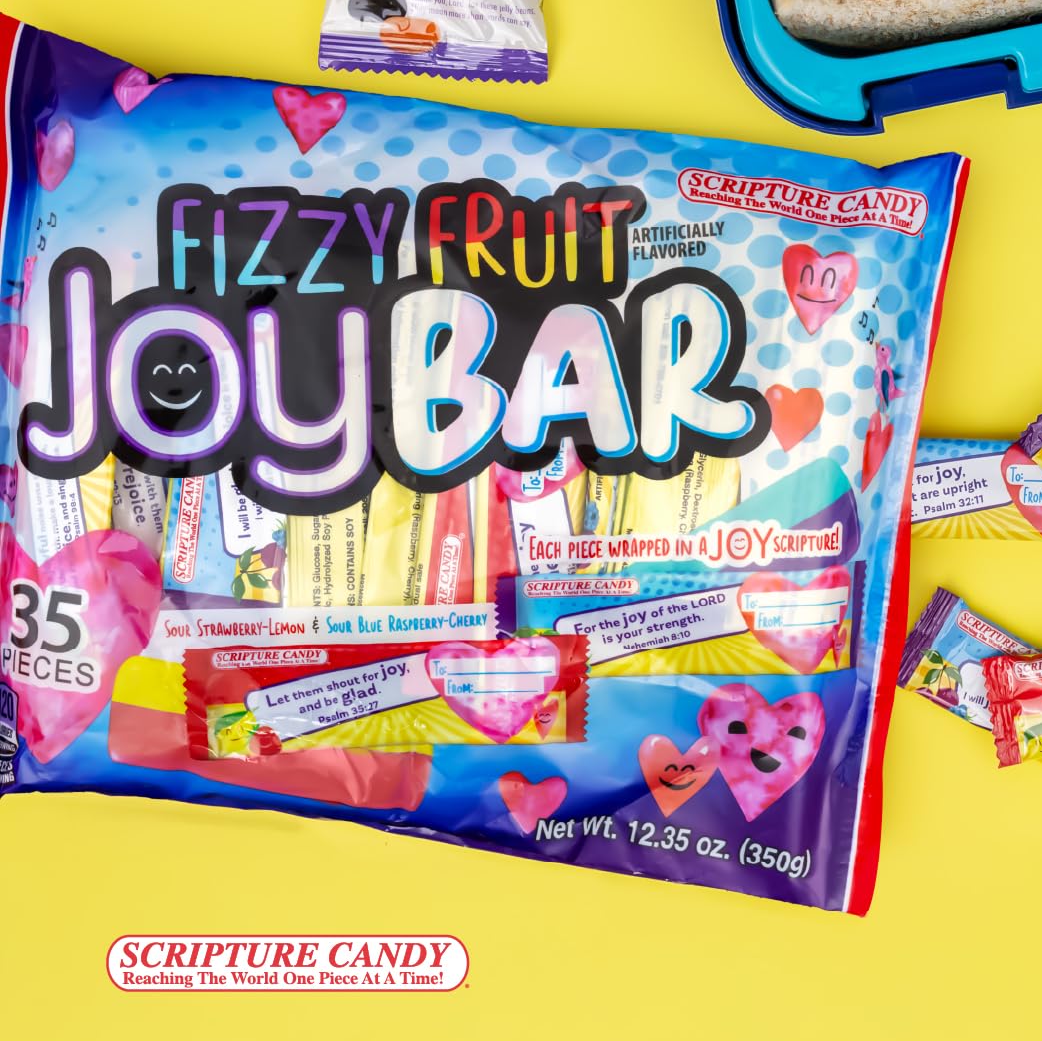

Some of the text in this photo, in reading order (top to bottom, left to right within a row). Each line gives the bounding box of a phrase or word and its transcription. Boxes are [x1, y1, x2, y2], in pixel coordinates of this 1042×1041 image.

[688, 173, 922, 217] SCRIPTURE CANDY
[689, 188, 913, 229] Reaching The World One Piece At A Time!
[172, 192, 633, 297] FIZZY FRUIT
[631, 221, 725, 244] ARTIFICIALLY
[632, 240, 706, 261] FLAVORED
[391, 282, 756, 475] BAR
[916, 466, 966, 485] for joy,
[920, 478, 988, 500] are upright
[923, 494, 984, 515] Psalm 32:11
[529, 527, 839, 561] EACH PIECE WRAPPED IN A JOY SCRIPTURE!
[10, 583, 82, 653] 35
[164, 611, 487, 637] SOUR STRAWBERRY-LEMON SOUR BLUE RASPBERRY-CHERRY
[574, 593, 726, 637] For the joy of the LORD
[601, 613, 705, 644] is your strength.
[3, 648, 95, 687] PIECES
[265, 662, 410, 708] Let them shout for joy,
[298, 682, 381, 714] and be glad.
[317, 700, 378, 723] Psalm 35:27
[535, 815, 812, 879] Net Wt. 12.35 oz. (350g)
